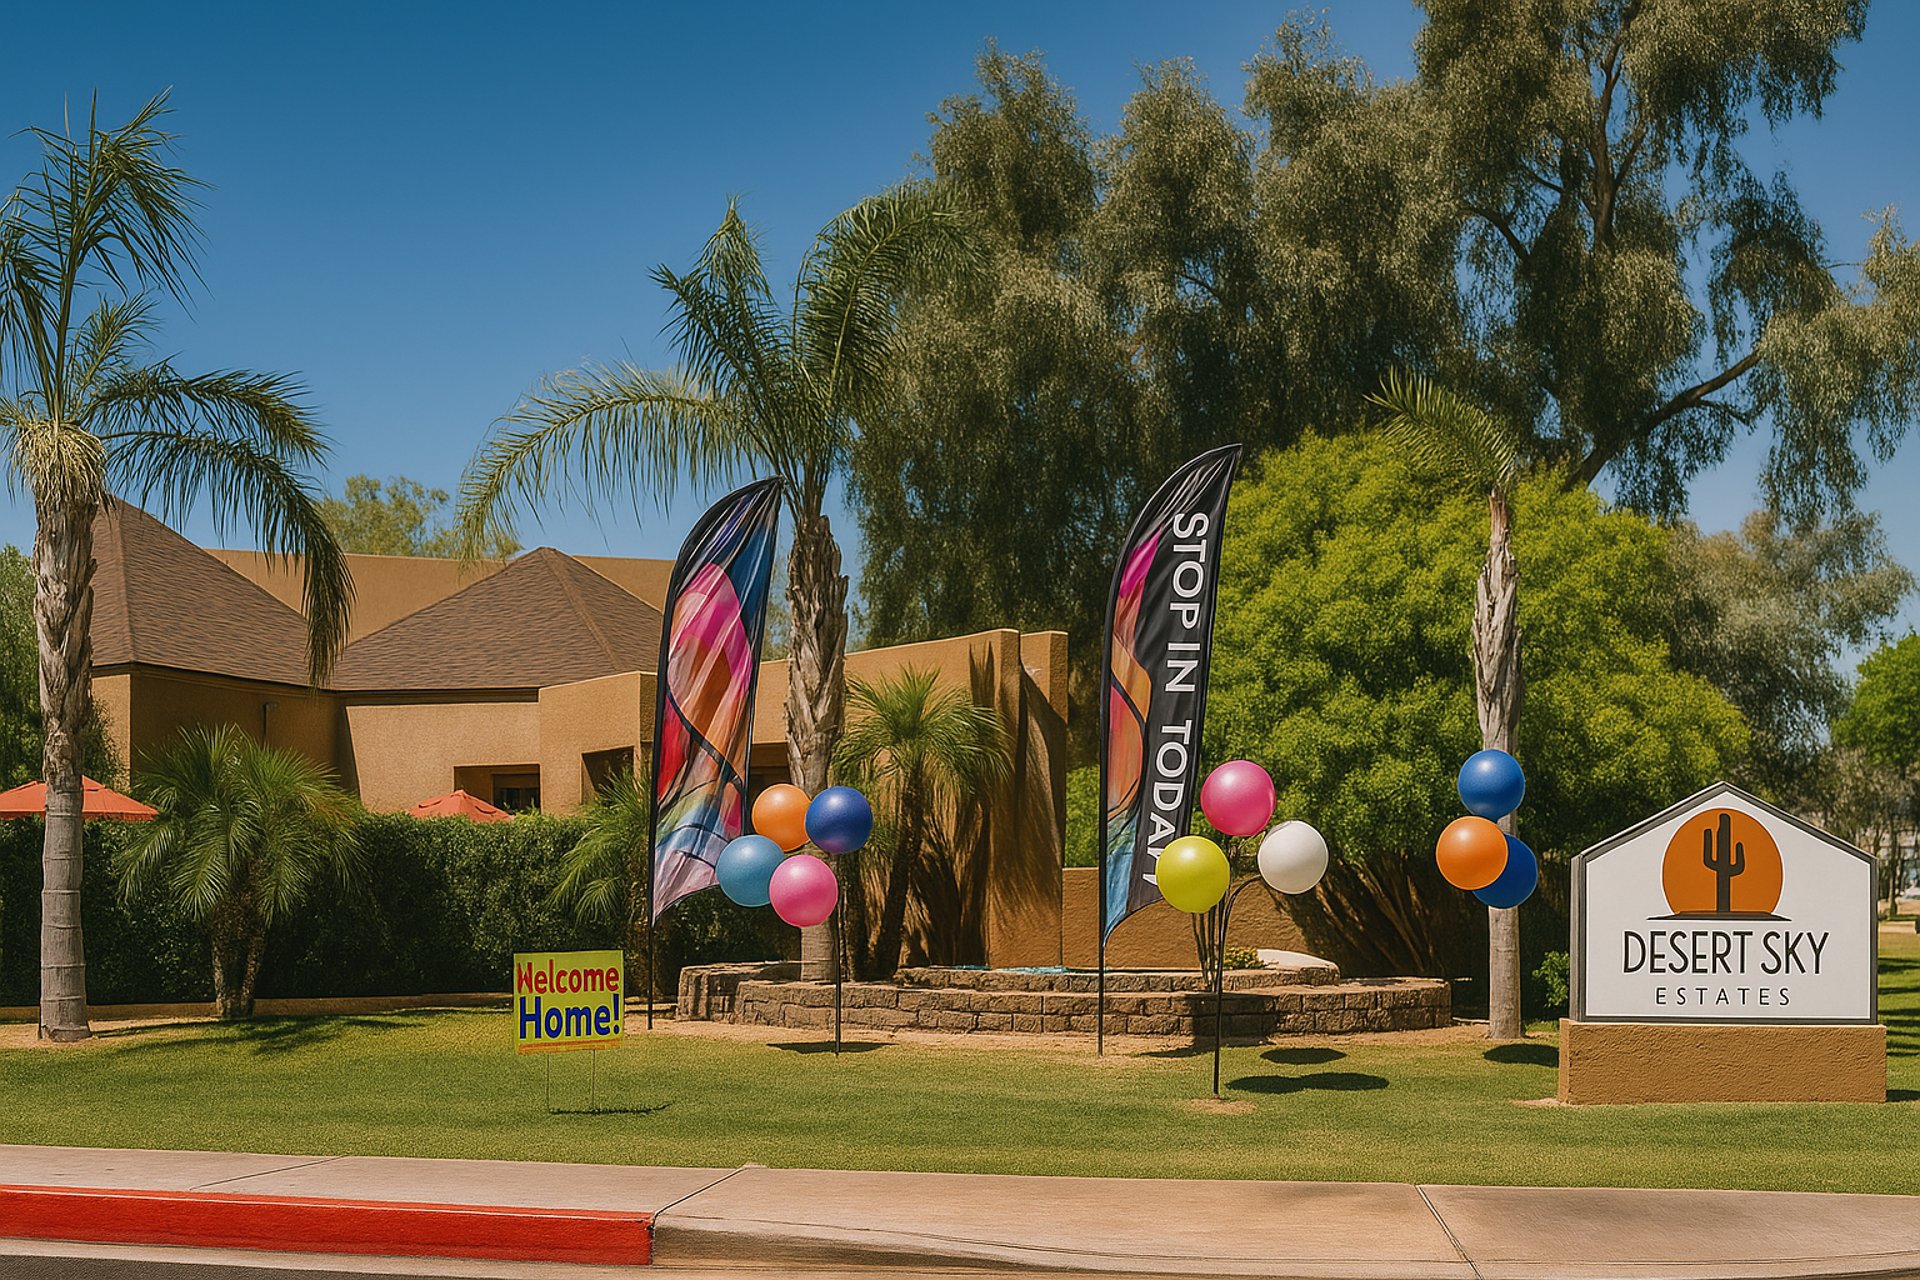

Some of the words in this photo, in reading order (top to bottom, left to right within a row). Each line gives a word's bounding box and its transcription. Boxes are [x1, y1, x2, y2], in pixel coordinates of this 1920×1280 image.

[1169, 512, 1210, 630] STOP
[1165, 642, 1201, 692] IN
[1623, 930, 1754, 974] DESERT
[1760, 930, 1830, 975] SKY
[517, 959, 620, 994] Welcome
[1655, 987, 1791, 1006] ESTATES
[519, 993, 620, 1039] Home!
